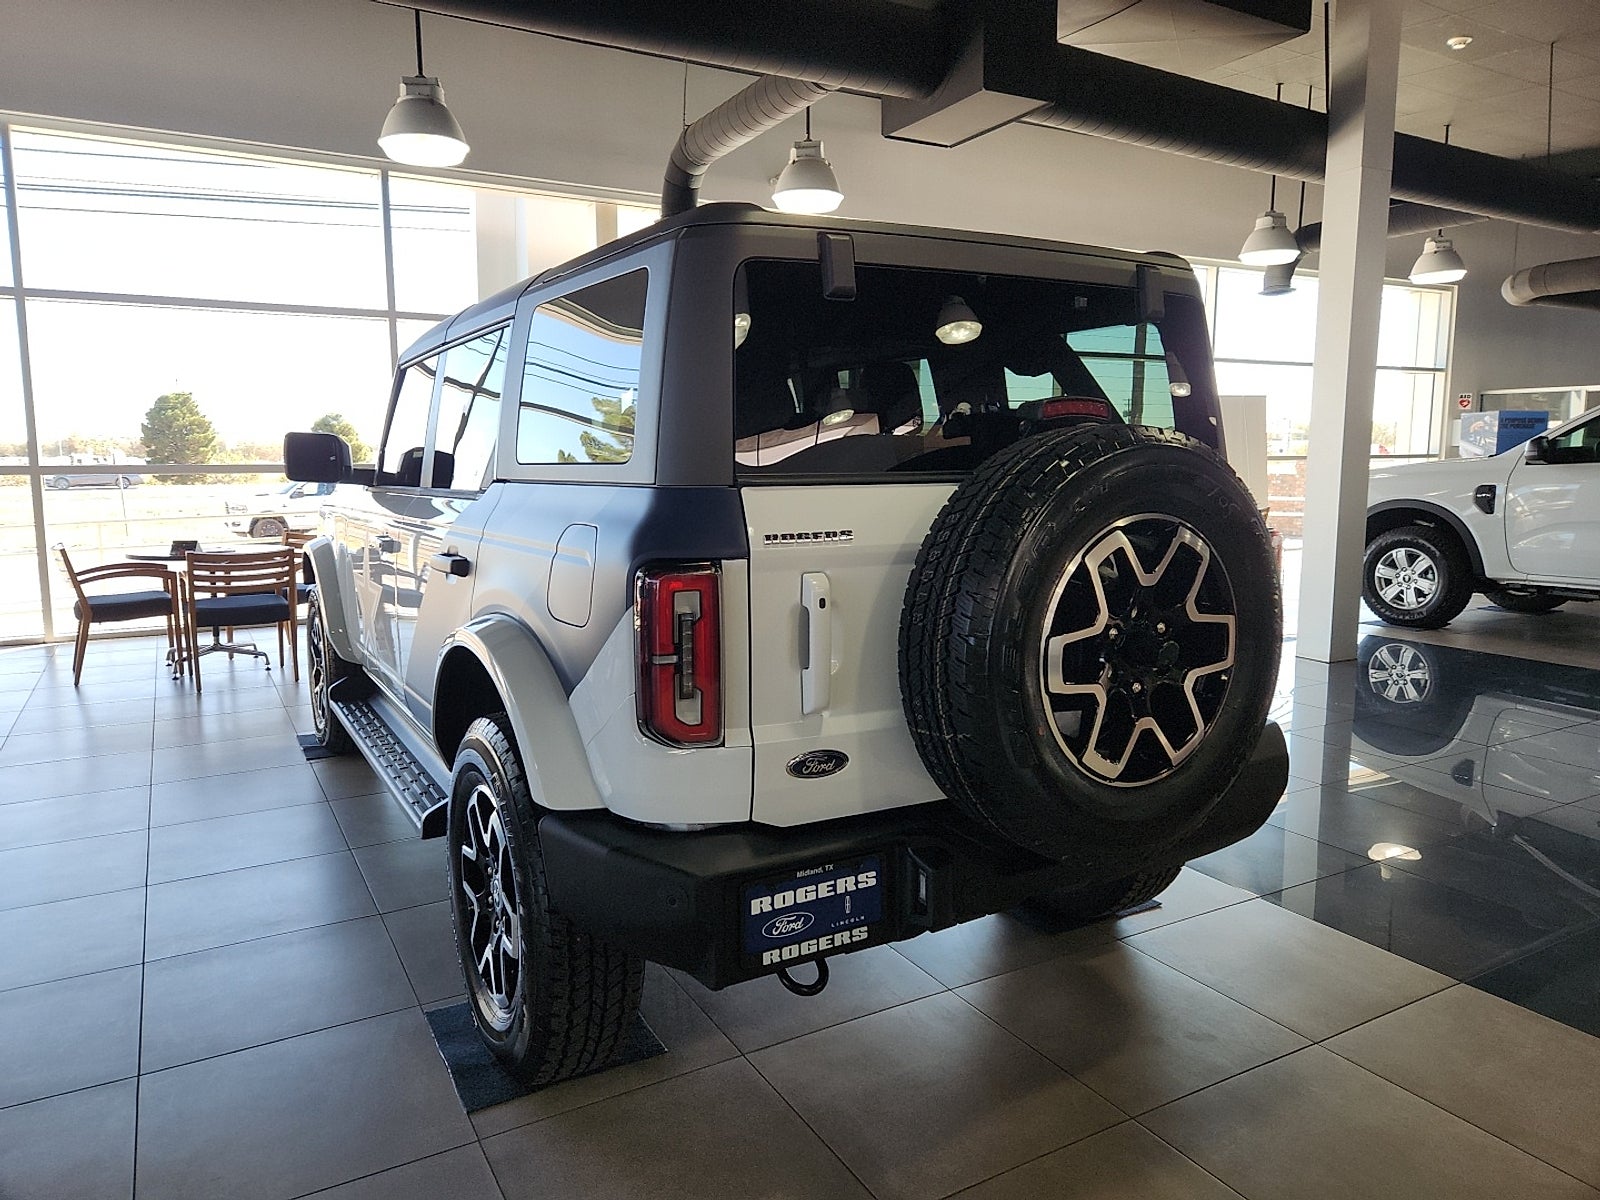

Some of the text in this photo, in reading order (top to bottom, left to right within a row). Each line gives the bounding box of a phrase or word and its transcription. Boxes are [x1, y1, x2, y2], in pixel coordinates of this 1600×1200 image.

[764, 530, 854, 545] ROGERS
[796, 864, 834, 878] Midland, TX
[751, 871, 877, 916] ROGERS
[771, 914, 806, 936] Ford
[831, 915, 865, 928] LINCOLN
[762, 926, 869, 966] ROGERS
